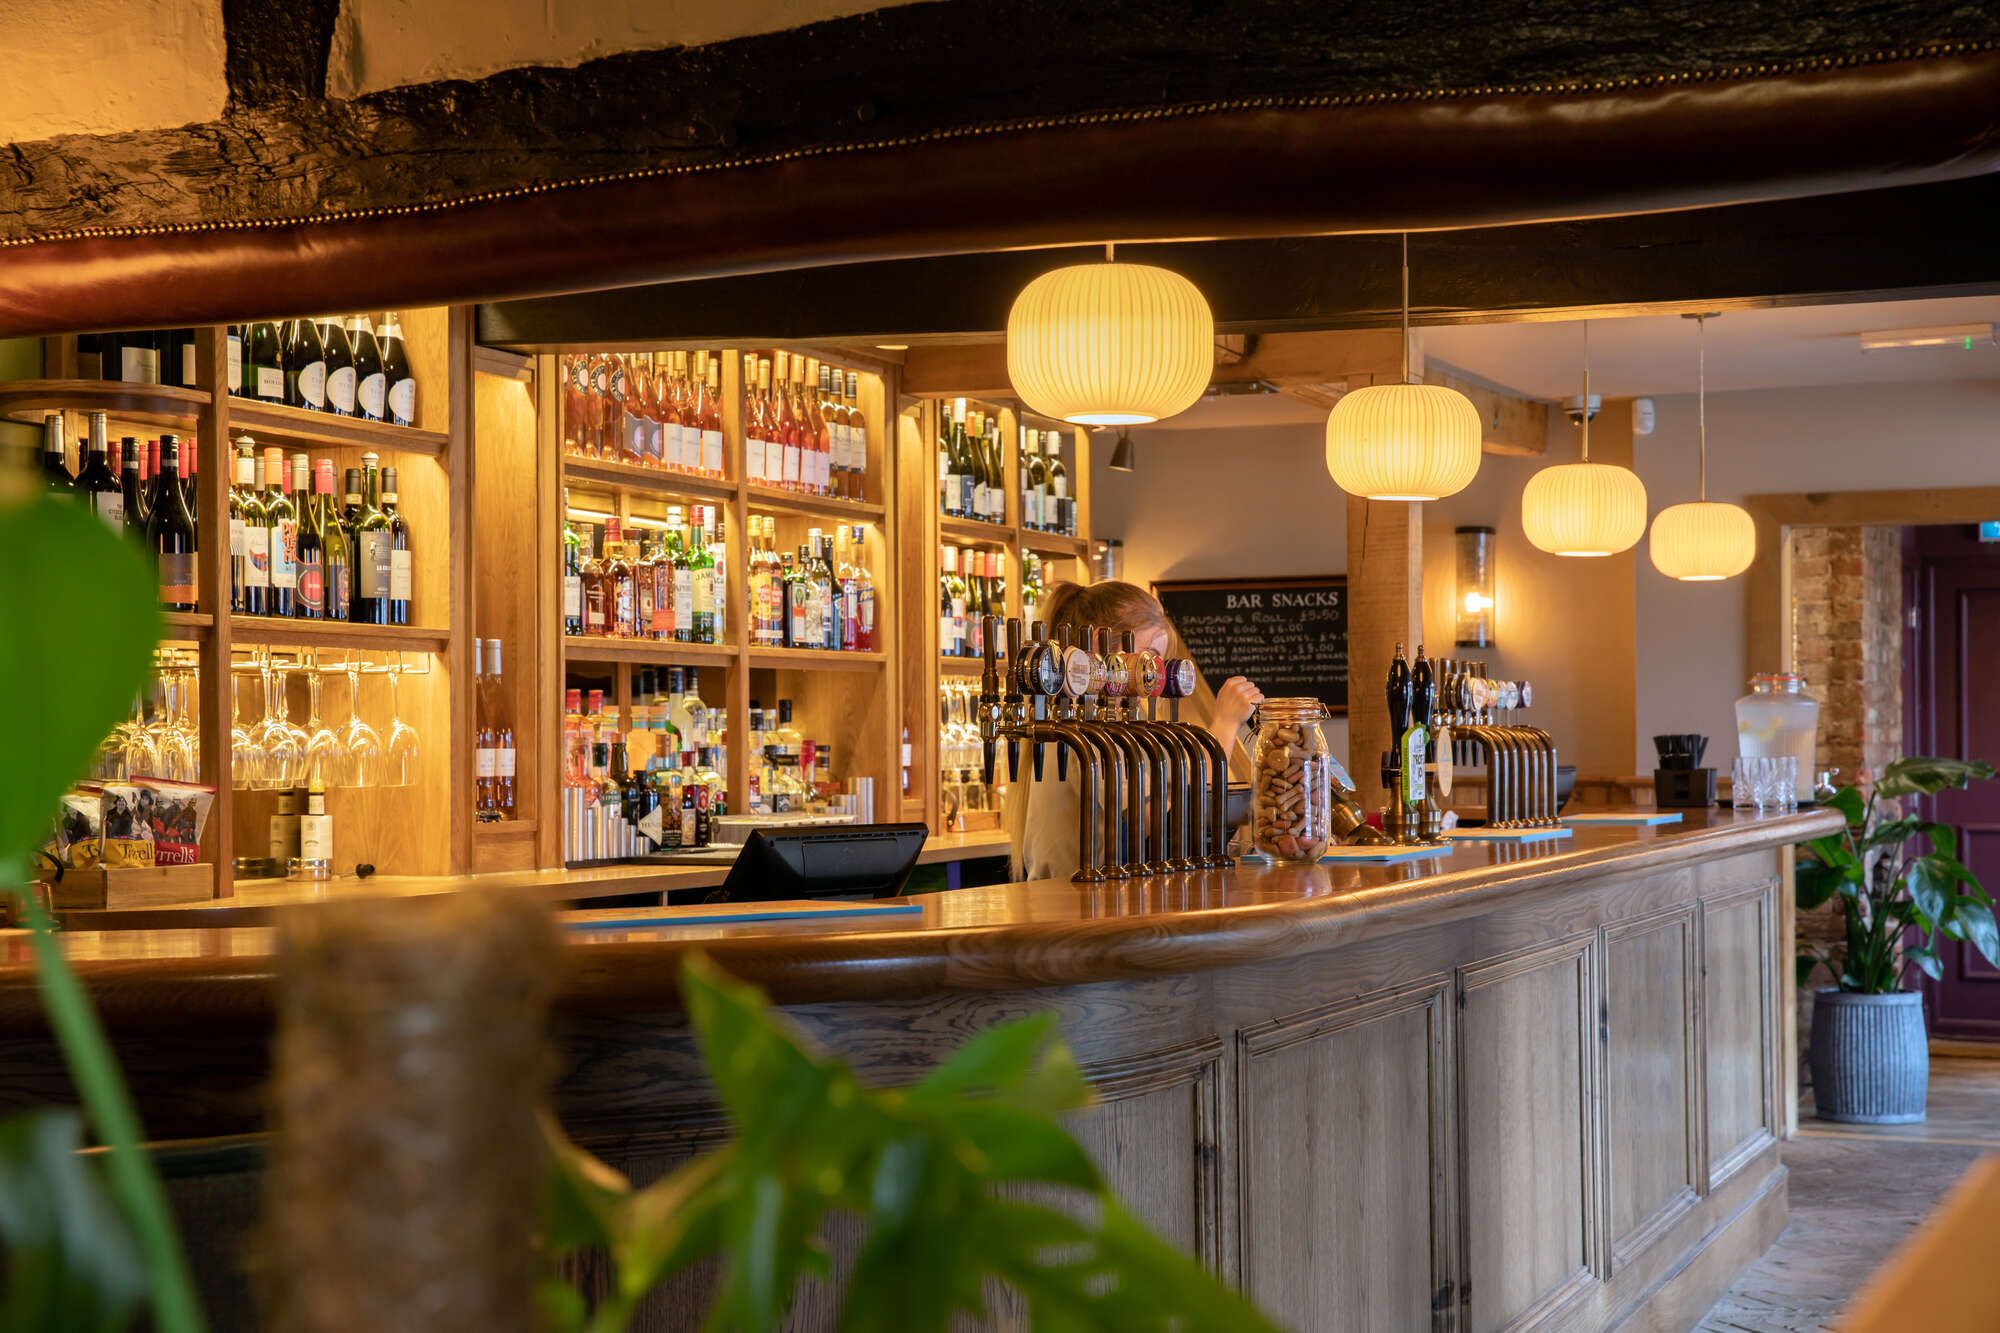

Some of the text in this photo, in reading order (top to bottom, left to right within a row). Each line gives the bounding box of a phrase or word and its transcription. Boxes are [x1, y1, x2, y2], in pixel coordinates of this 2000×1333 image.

[1226, 591, 1339, 609] BAR SNACKS
[1182, 614, 1244, 625] SAUSAGE
[1182, 626, 1226, 636] SCOTCH
[1226, 635, 1266, 645] FENNEL
